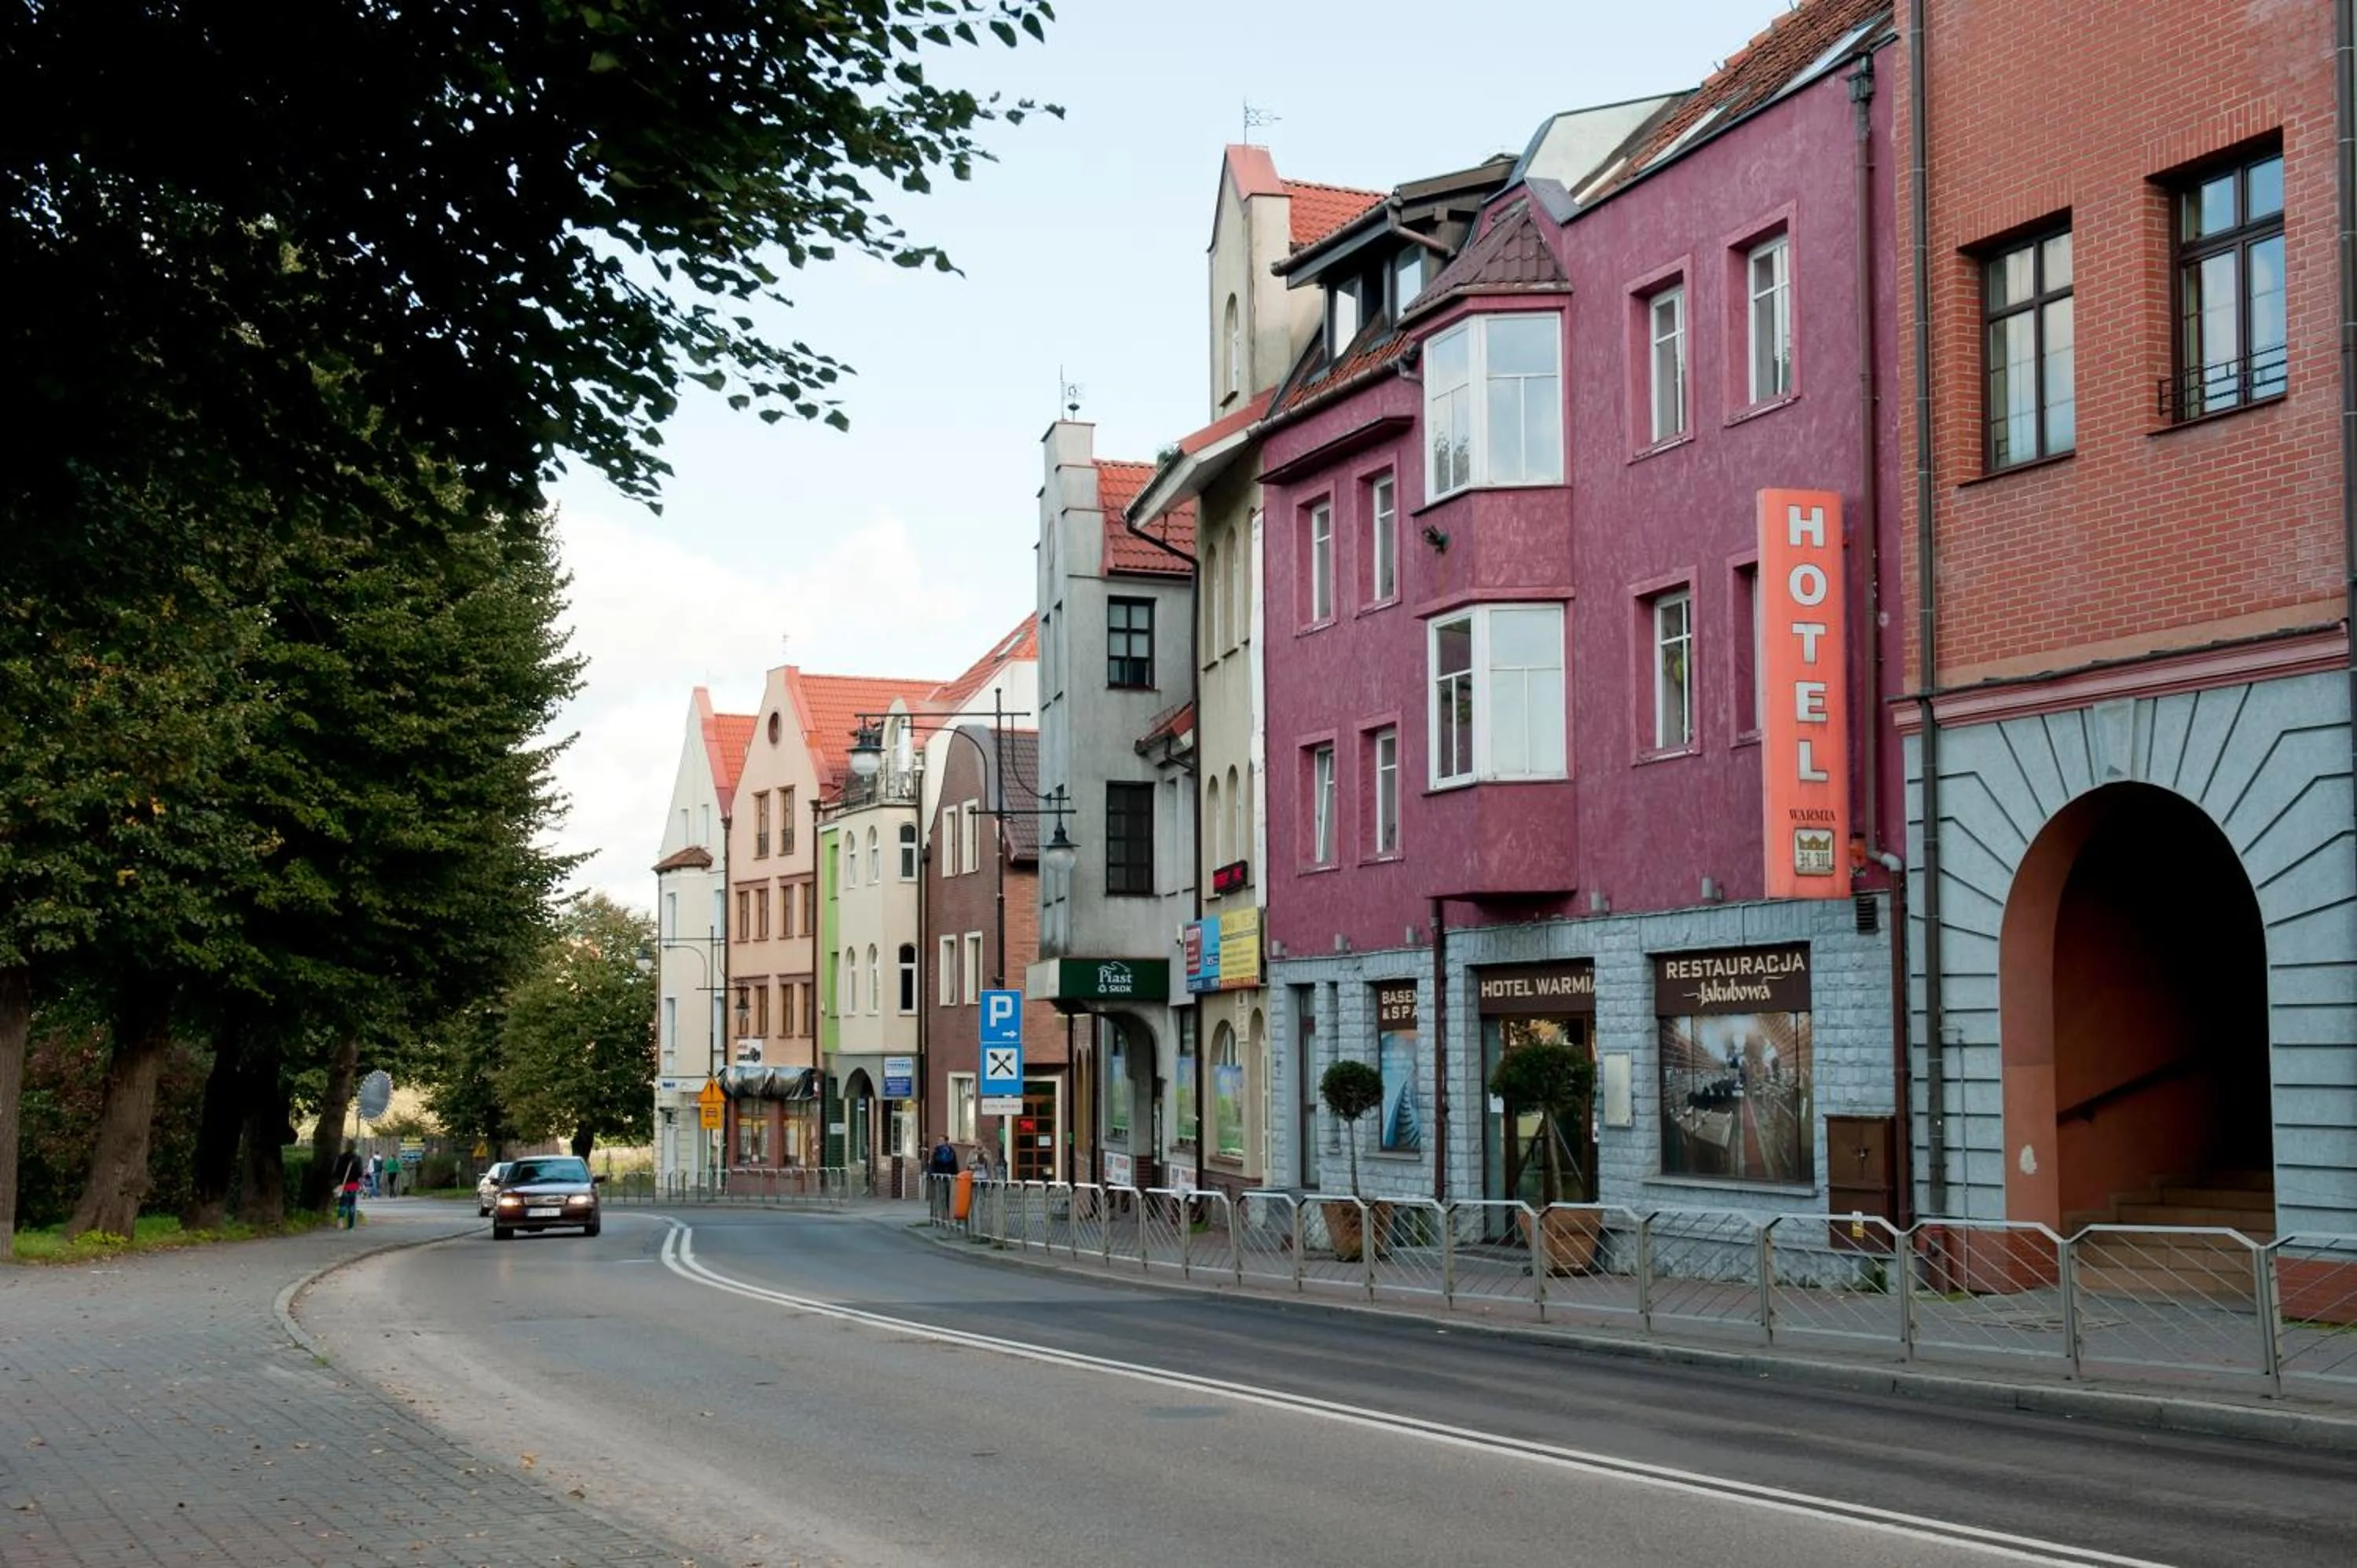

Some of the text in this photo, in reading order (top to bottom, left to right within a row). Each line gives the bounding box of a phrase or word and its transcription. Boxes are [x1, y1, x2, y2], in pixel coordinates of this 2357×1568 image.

[1787, 504, 1829, 782] HOTEL
[1789, 808, 1836, 822] WARMIA
[1099, 967, 1133, 984] Piast
[1666, 952, 1805, 980] RESTAURACJA
[1481, 979, 1534, 998] HOTEL
[1683, 976, 1785, 1007] Jakubowa
[989, 995, 1013, 1028] P
